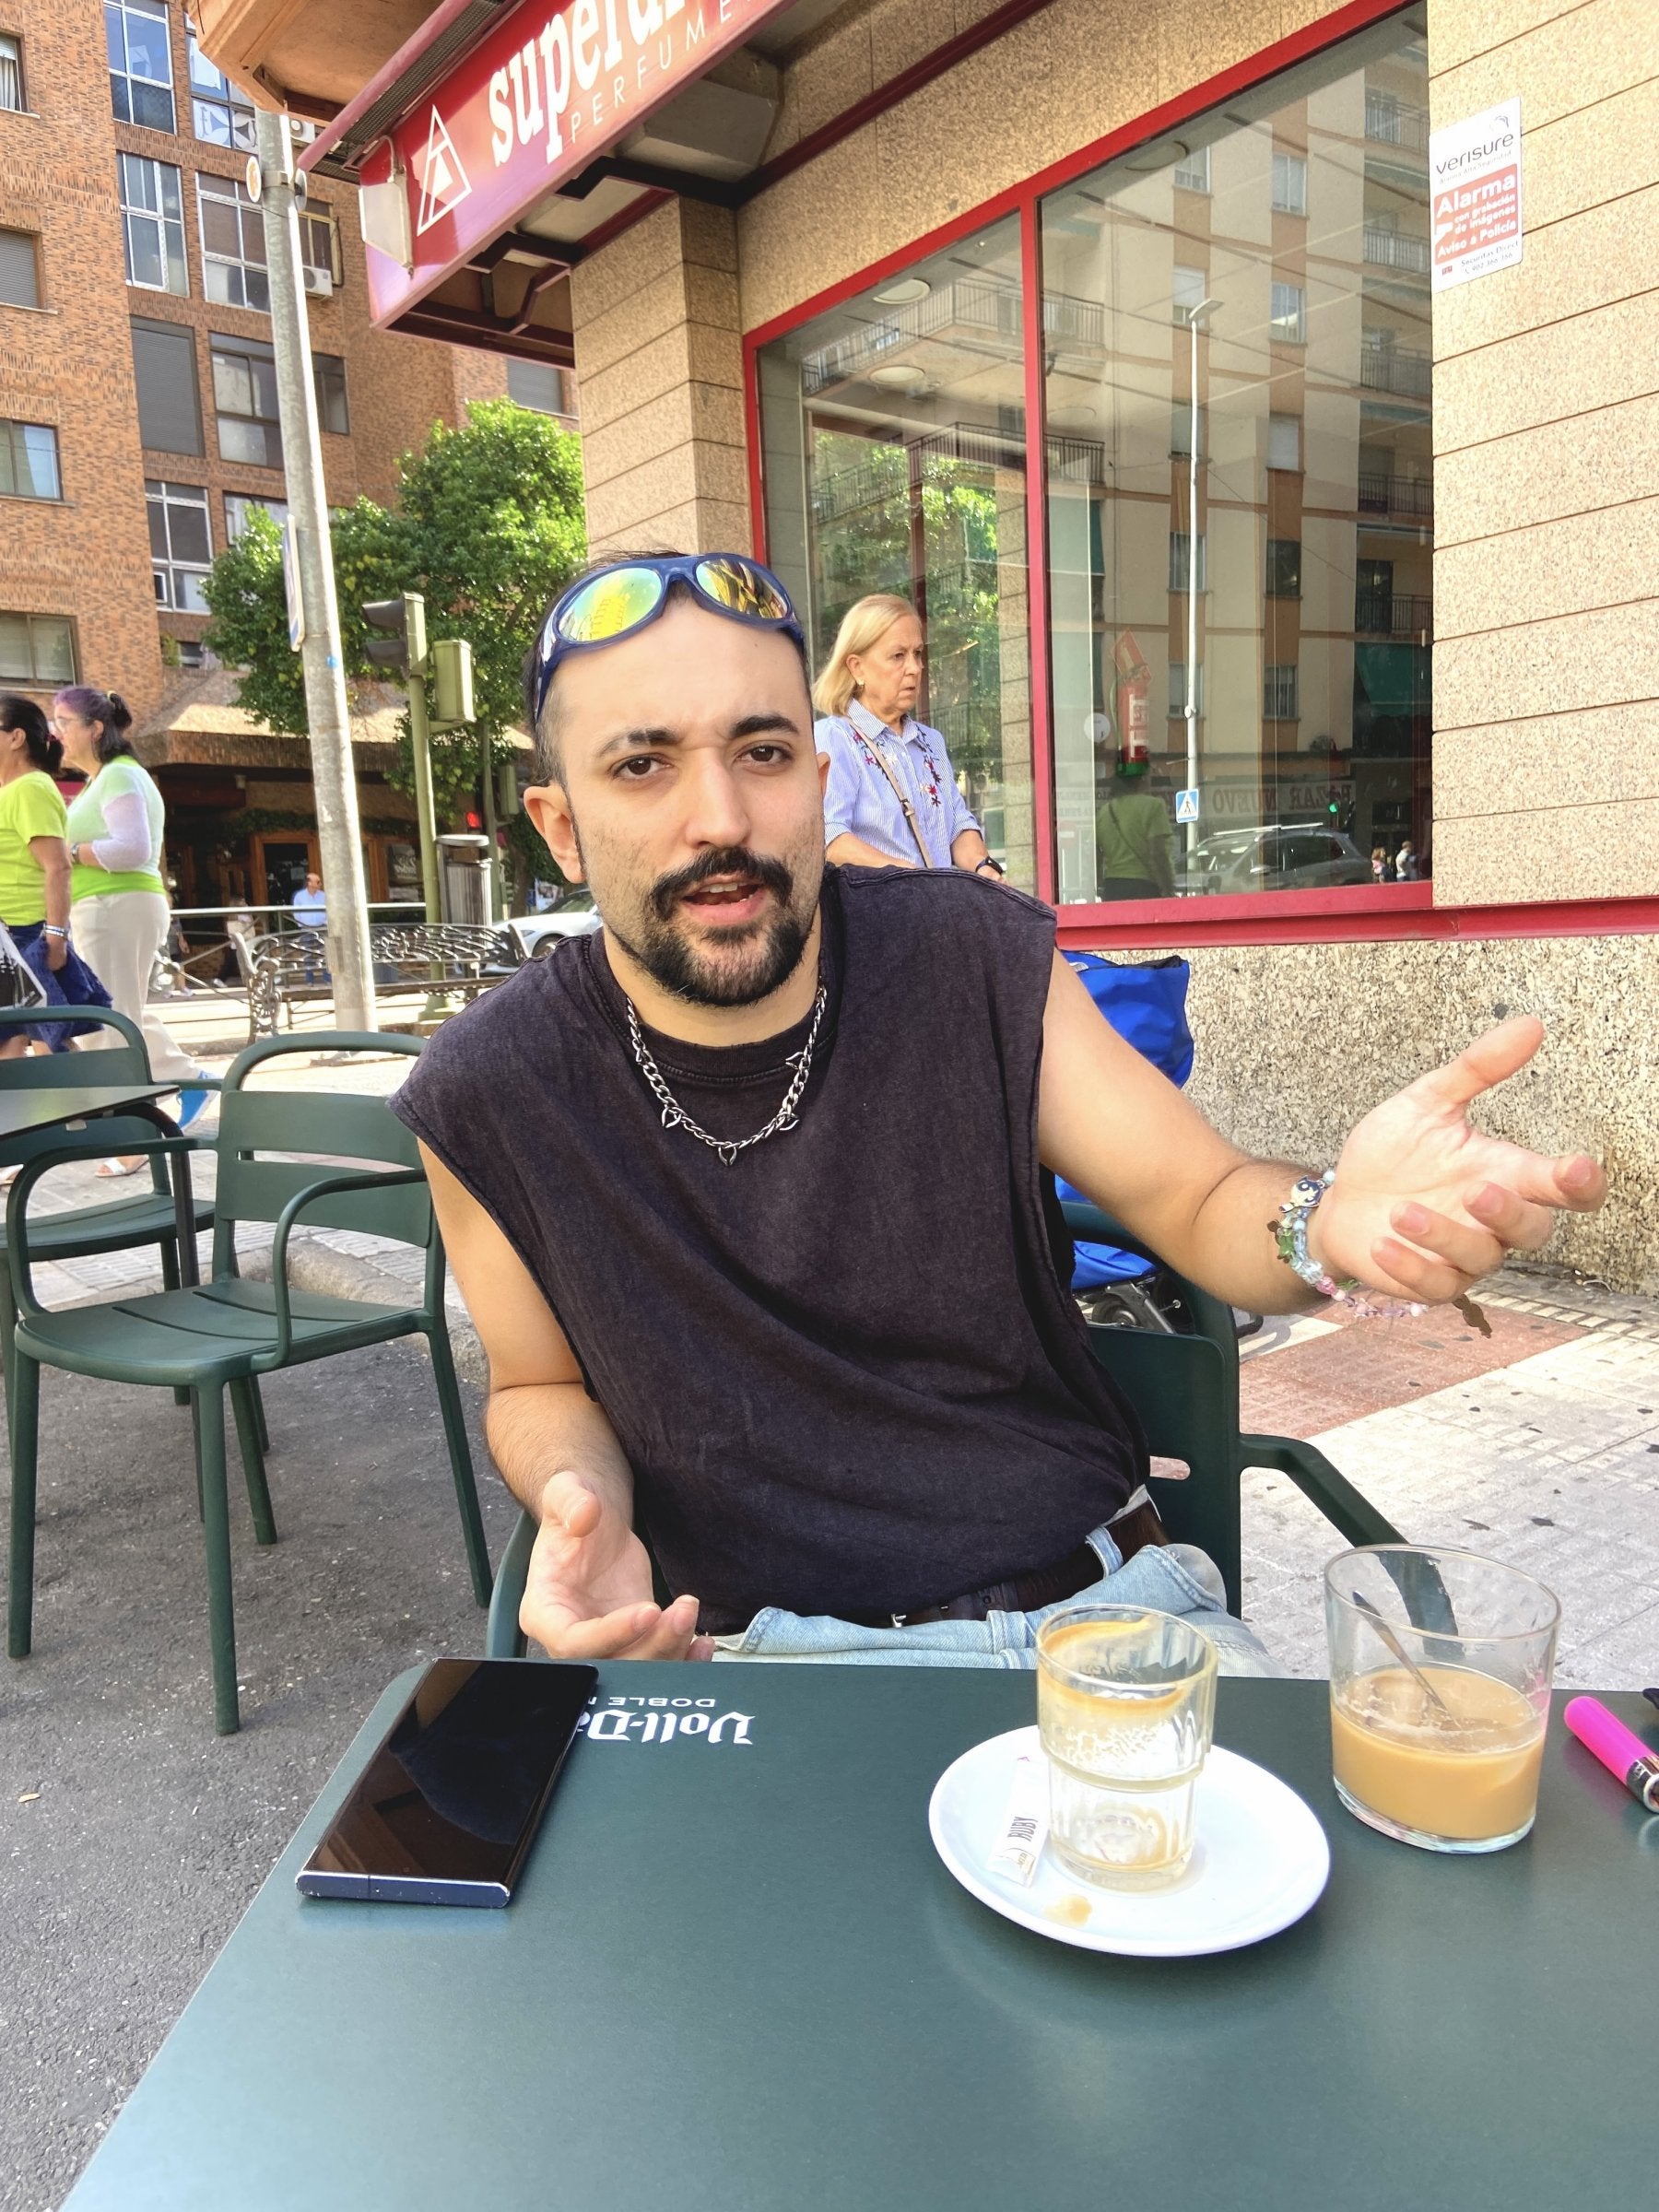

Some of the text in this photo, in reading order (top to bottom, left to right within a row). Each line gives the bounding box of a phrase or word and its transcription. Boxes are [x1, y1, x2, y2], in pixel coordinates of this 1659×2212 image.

[571, 0, 750, 144] PERFUME
[1435, 134, 1514, 175] verisure
[1436, 174, 1515, 218] Alarma
[1453, 194, 1516, 224] con grabación
[1454, 205, 1516, 235] de imágenes
[1437, 219, 1516, 259] Aviso a Policía
[1461, 239, 1519, 267] Securitas Direct
[608, 1696, 716, 1708] DOBLE
[1006, 1816, 1039, 1842] RUBY
